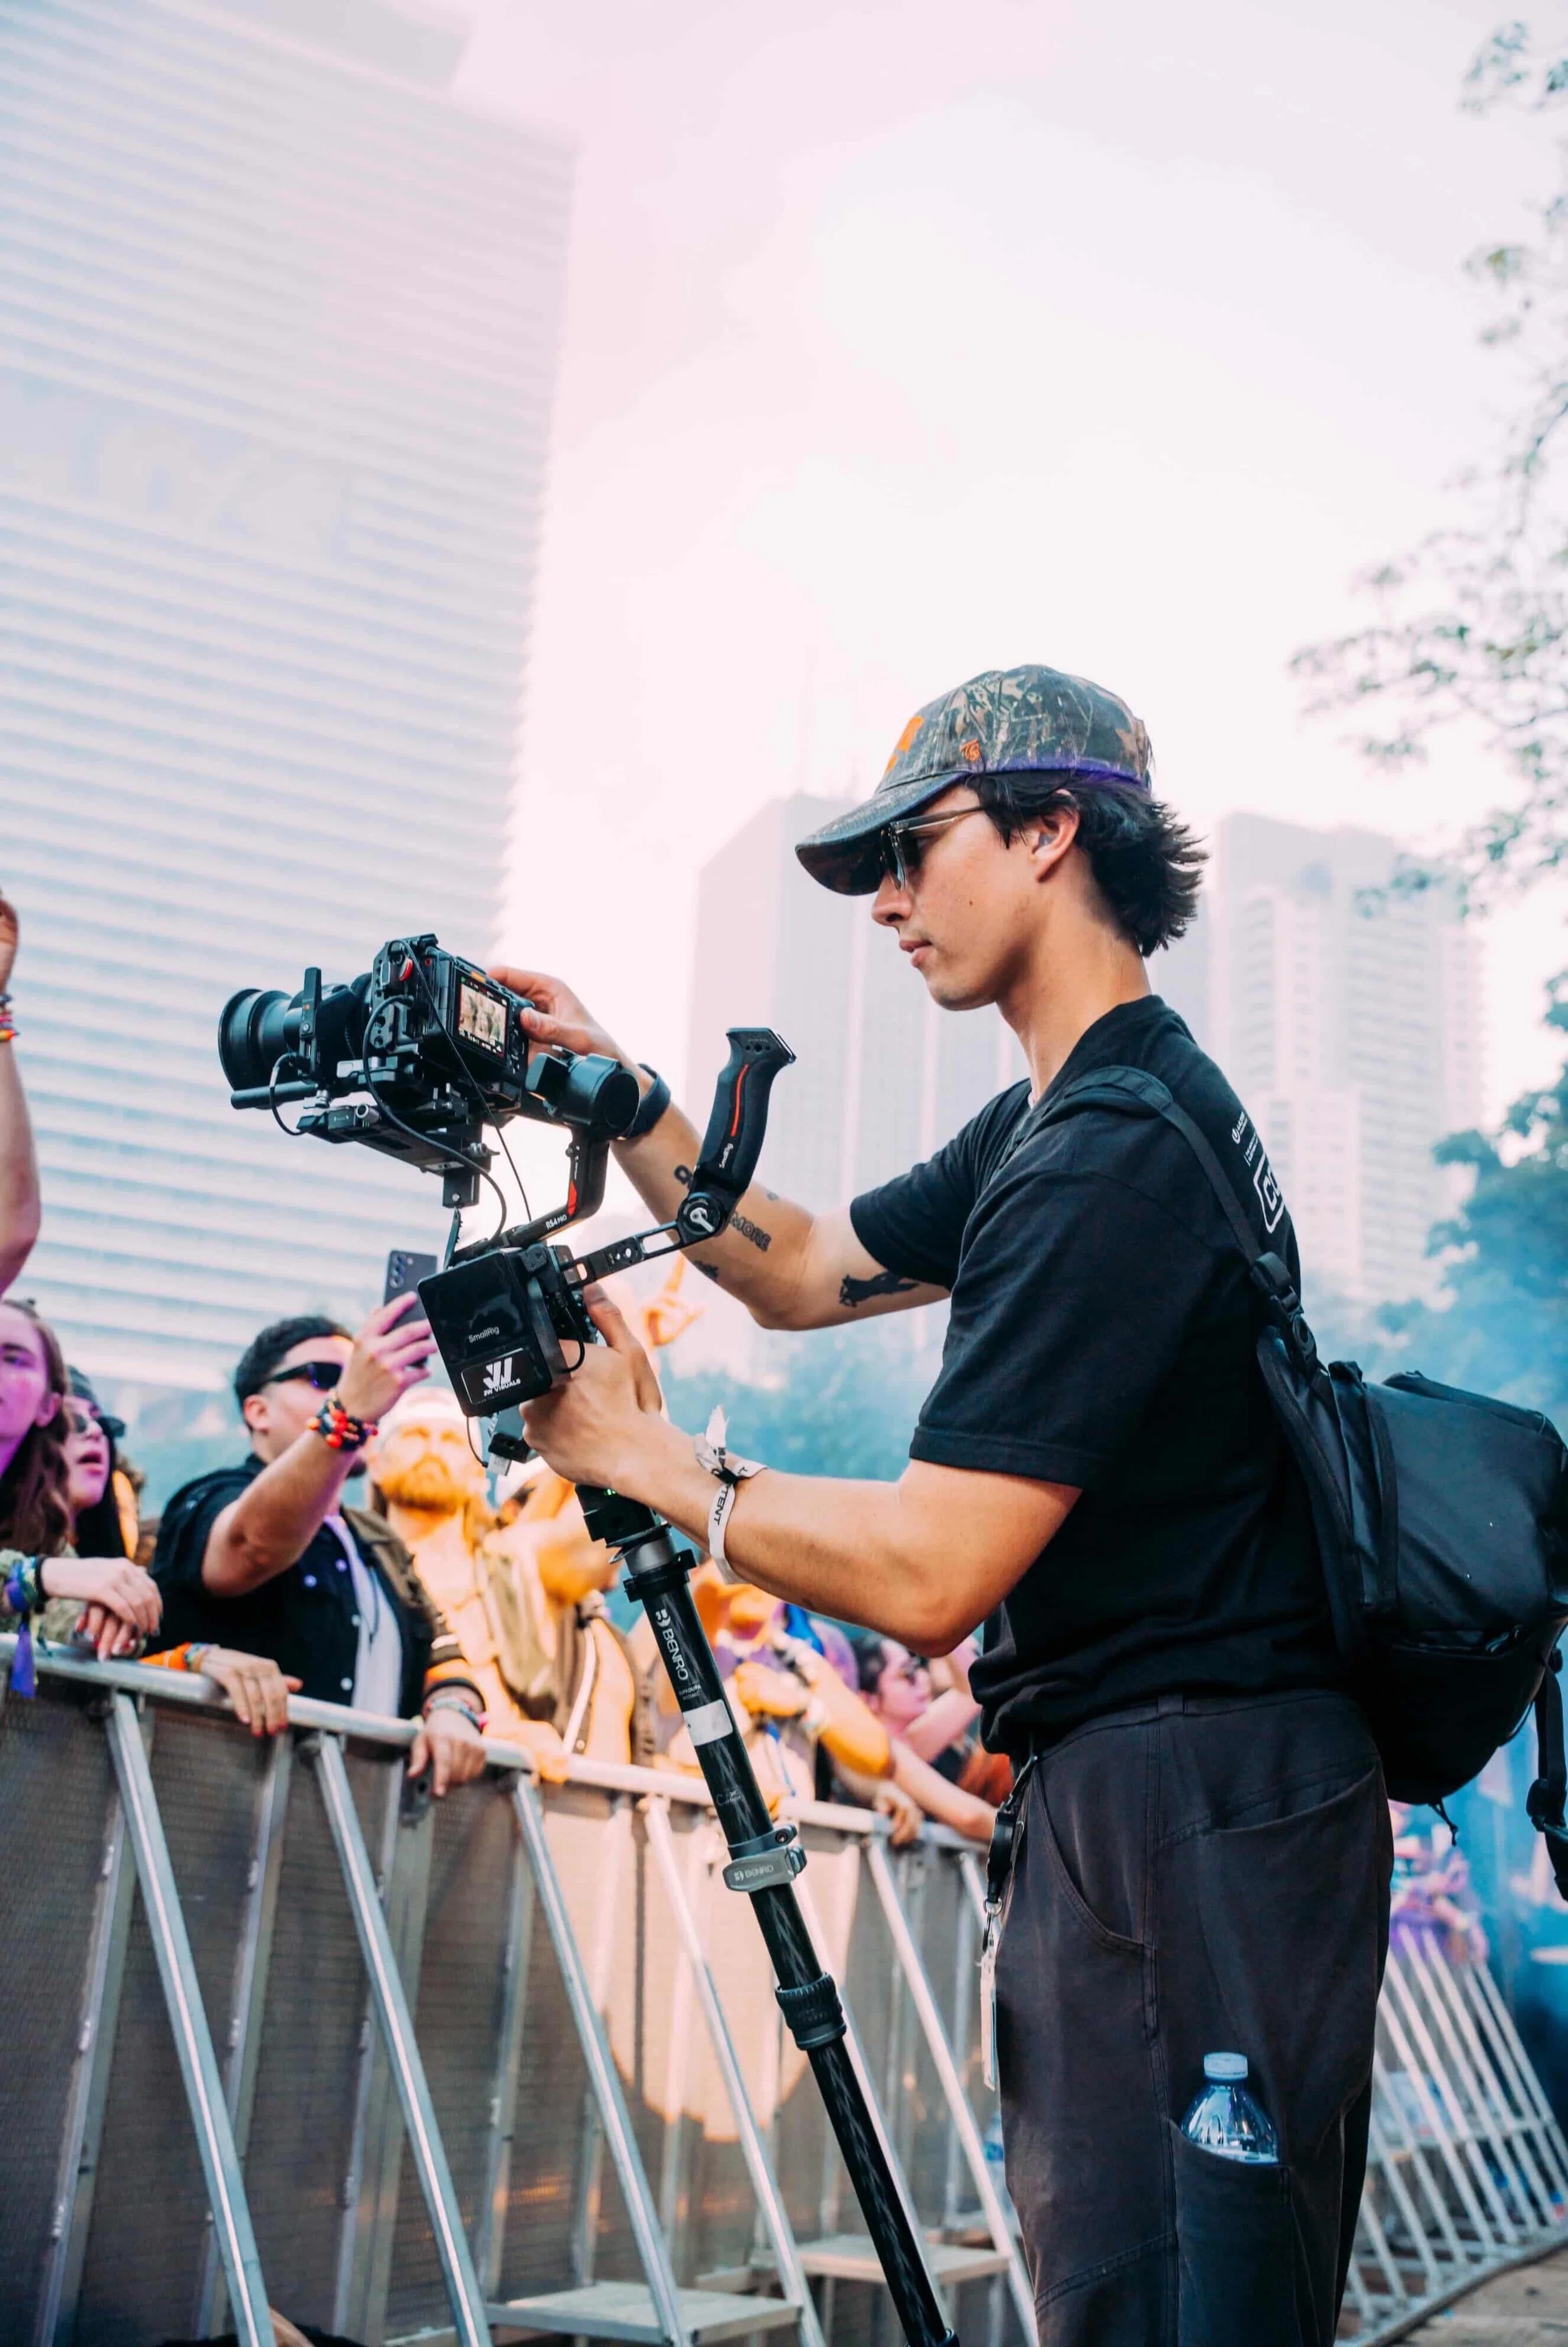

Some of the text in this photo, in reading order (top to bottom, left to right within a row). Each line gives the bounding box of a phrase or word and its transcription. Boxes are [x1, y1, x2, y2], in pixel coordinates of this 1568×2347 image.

[719, 1143, 733, 1168] SmallRig
[546, 1215, 567, 1229] RS4 PRO
[469, 1327, 499, 1343] SmallRig
[495, 1378, 521, 1392] VISUALS
[662, 1628, 689, 1681] BENRO
[744, 1865, 774, 1878] BENRO
